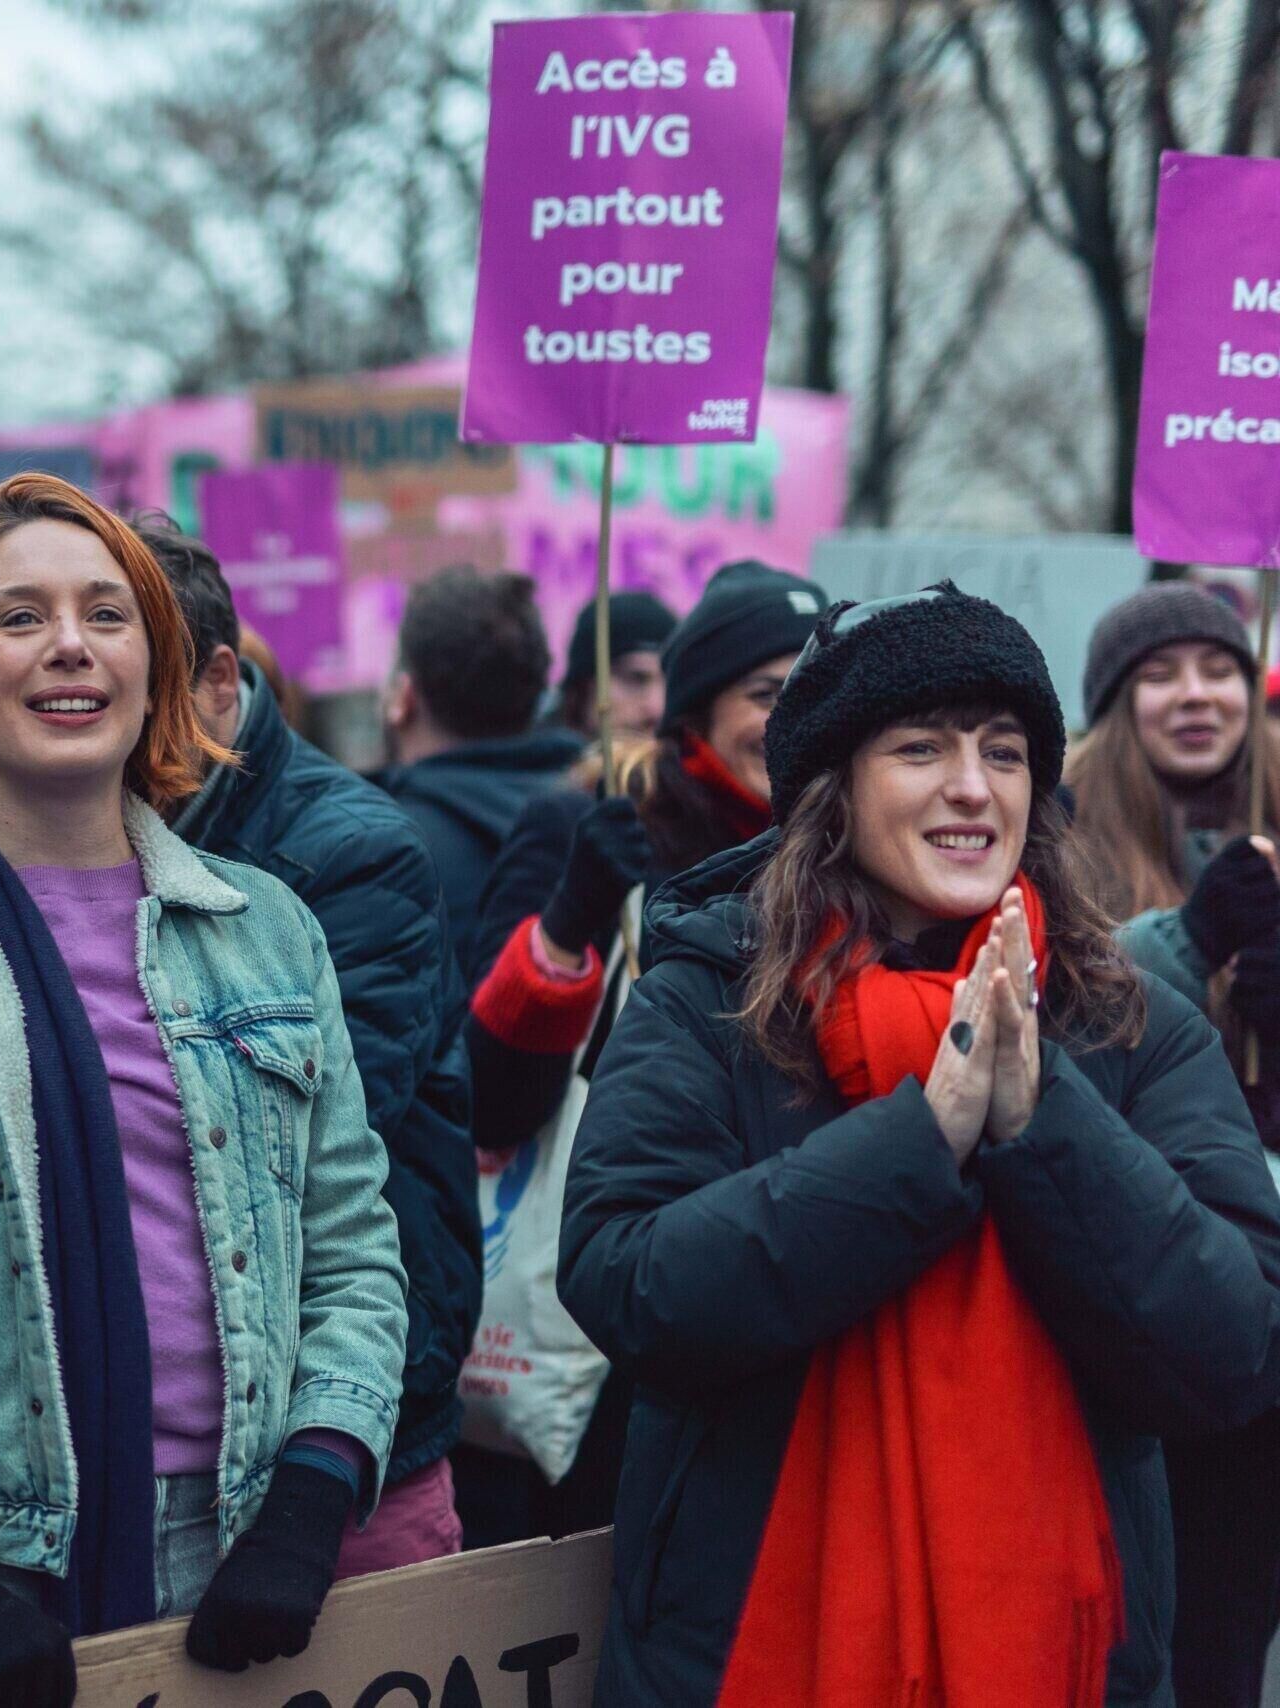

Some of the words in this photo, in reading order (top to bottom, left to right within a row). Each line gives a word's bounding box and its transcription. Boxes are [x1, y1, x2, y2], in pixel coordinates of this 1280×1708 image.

[537, 48, 686, 93] Accès
[705, 48, 736, 87] à
[571, 115, 689, 158] l'IVG
[532, 187, 723, 239] partout
[561, 262, 683, 305] pour
[525, 324, 711, 363] toustes
[1219, 342, 1280, 378] iso
[688, 410, 747, 431] toutes
[702, 399, 749, 415] nous
